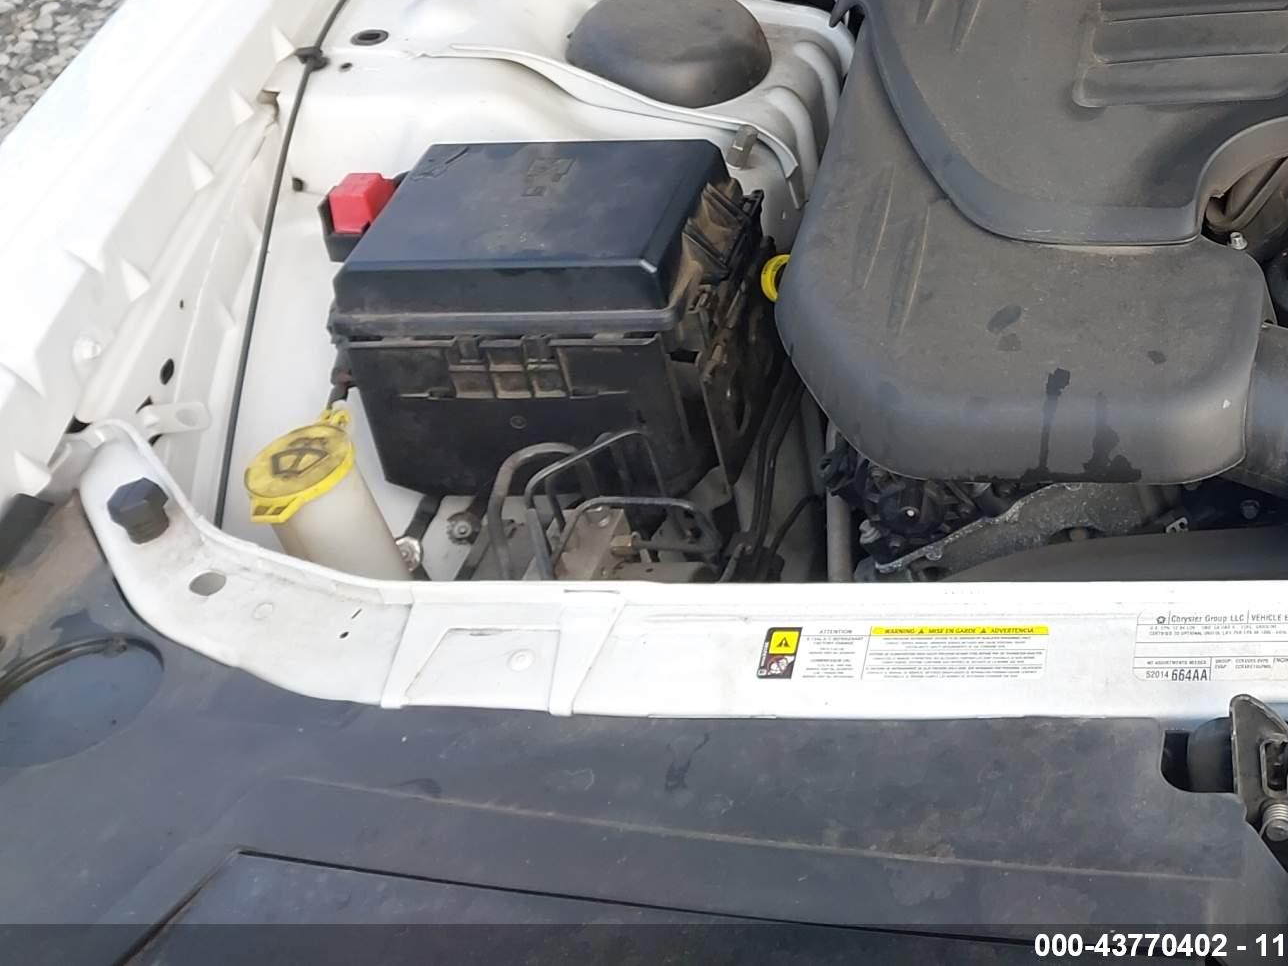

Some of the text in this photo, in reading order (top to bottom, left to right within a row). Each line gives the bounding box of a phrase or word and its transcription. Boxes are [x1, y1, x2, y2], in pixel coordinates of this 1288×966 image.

[1171, 615, 1202, 623] Chrysler
[1205, 614, 1228, 623] Group
[1251, 613, 1281, 621] VEHICLE
[1171, 668, 1208, 681] 664AA
